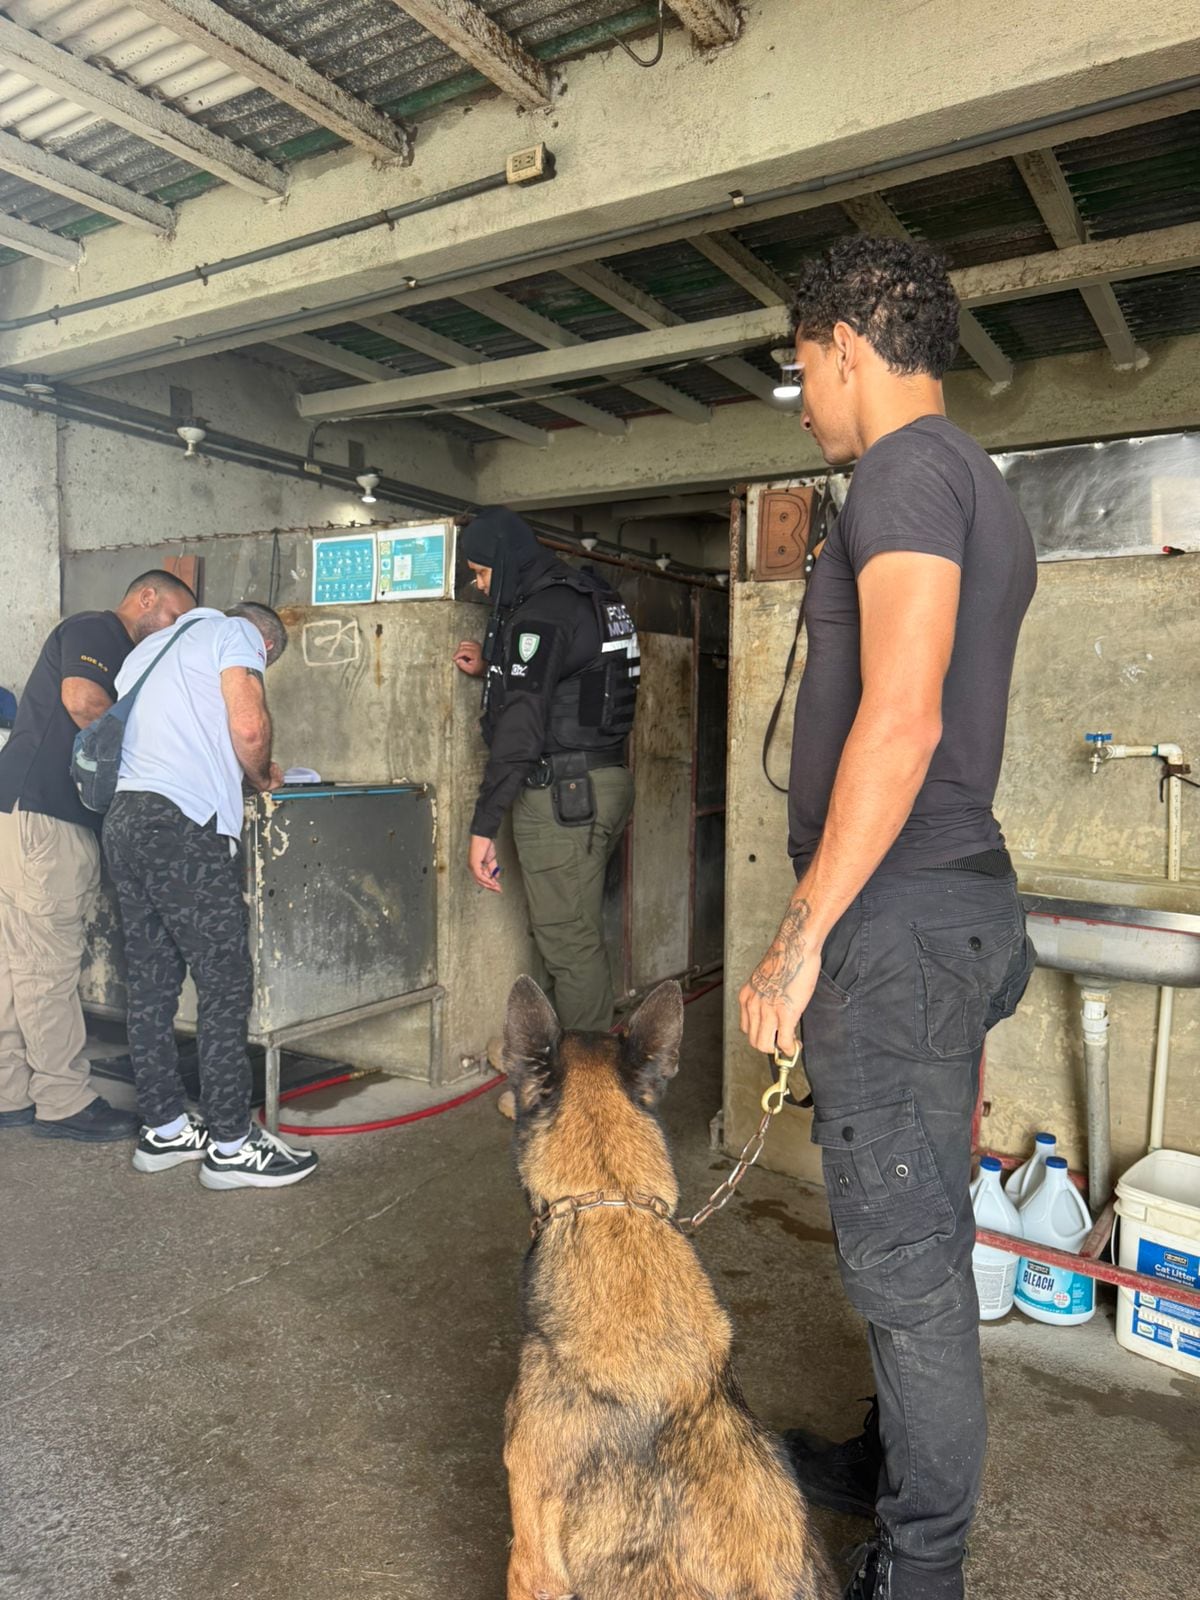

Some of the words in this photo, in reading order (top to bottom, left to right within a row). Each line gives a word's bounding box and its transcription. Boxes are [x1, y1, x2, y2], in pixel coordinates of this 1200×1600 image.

[1023, 1269, 1055, 1291] BLEACH
[1154, 1263, 1170, 1275] Cat
[1171, 1269, 1197, 1282] Litter
